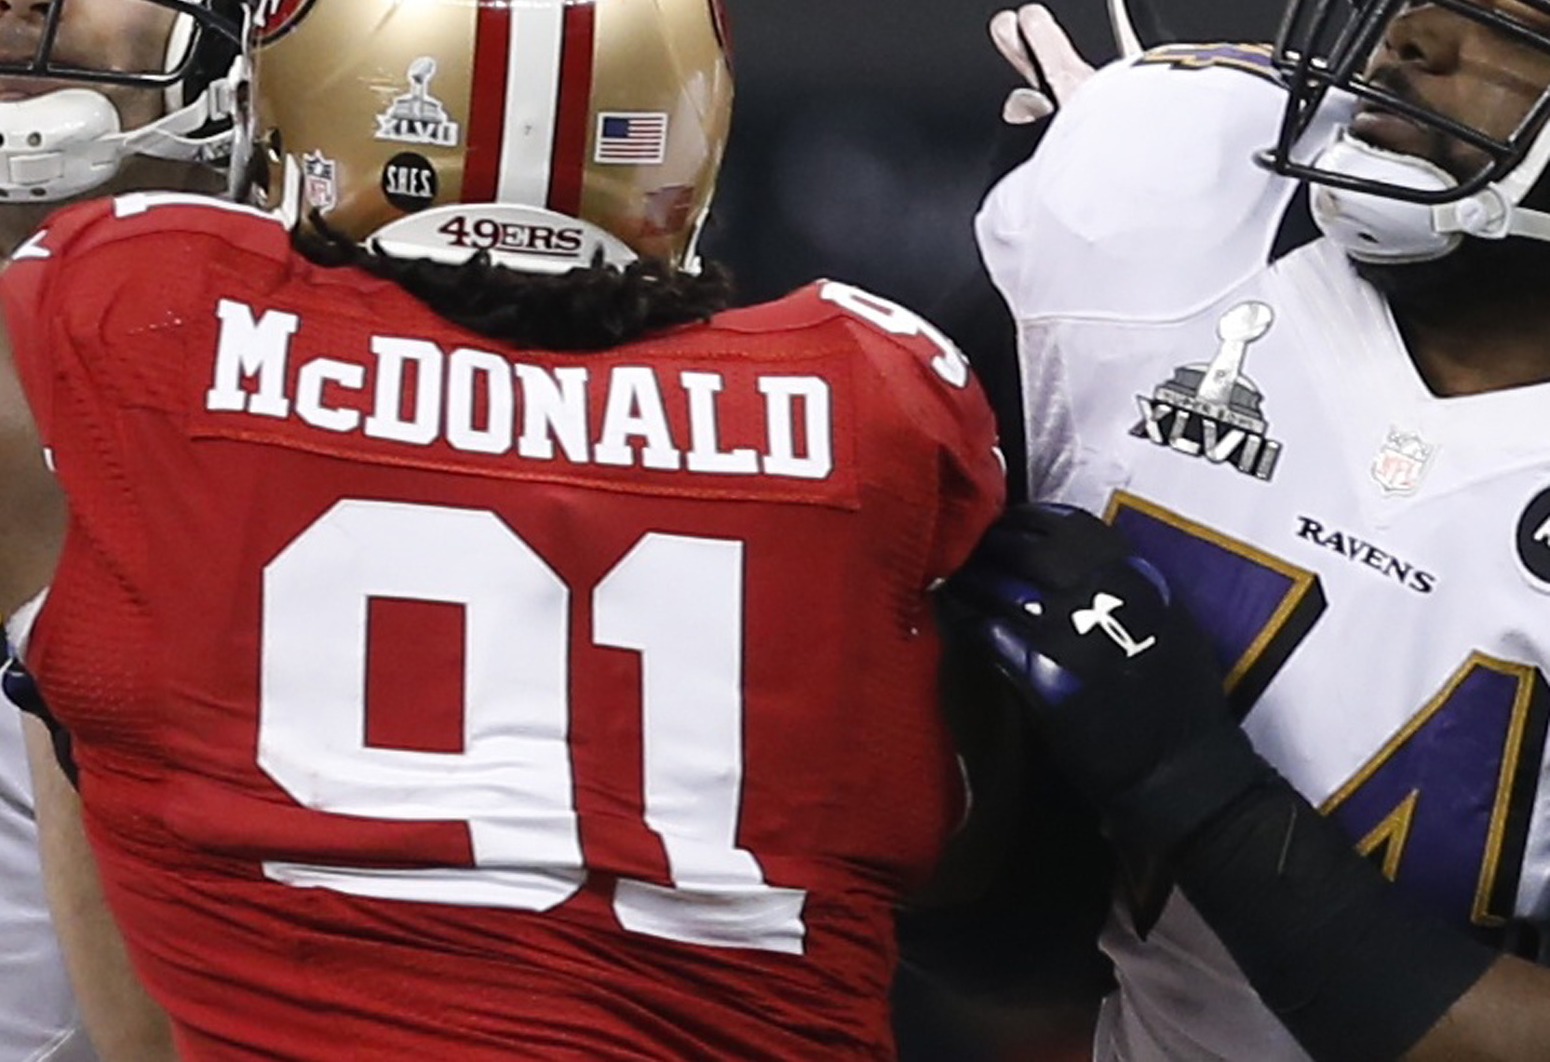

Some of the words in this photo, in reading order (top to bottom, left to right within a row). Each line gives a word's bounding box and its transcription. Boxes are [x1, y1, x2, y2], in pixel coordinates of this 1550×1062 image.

[374, 114, 459, 146] XLVII
[438, 215, 583, 251] 49ERS
[205, 298, 833, 480] McDONALD
[1128, 395, 1282, 482] XLVII
[1297, 515, 1437, 594] RAVENS
[257, 498, 807, 956] 91
